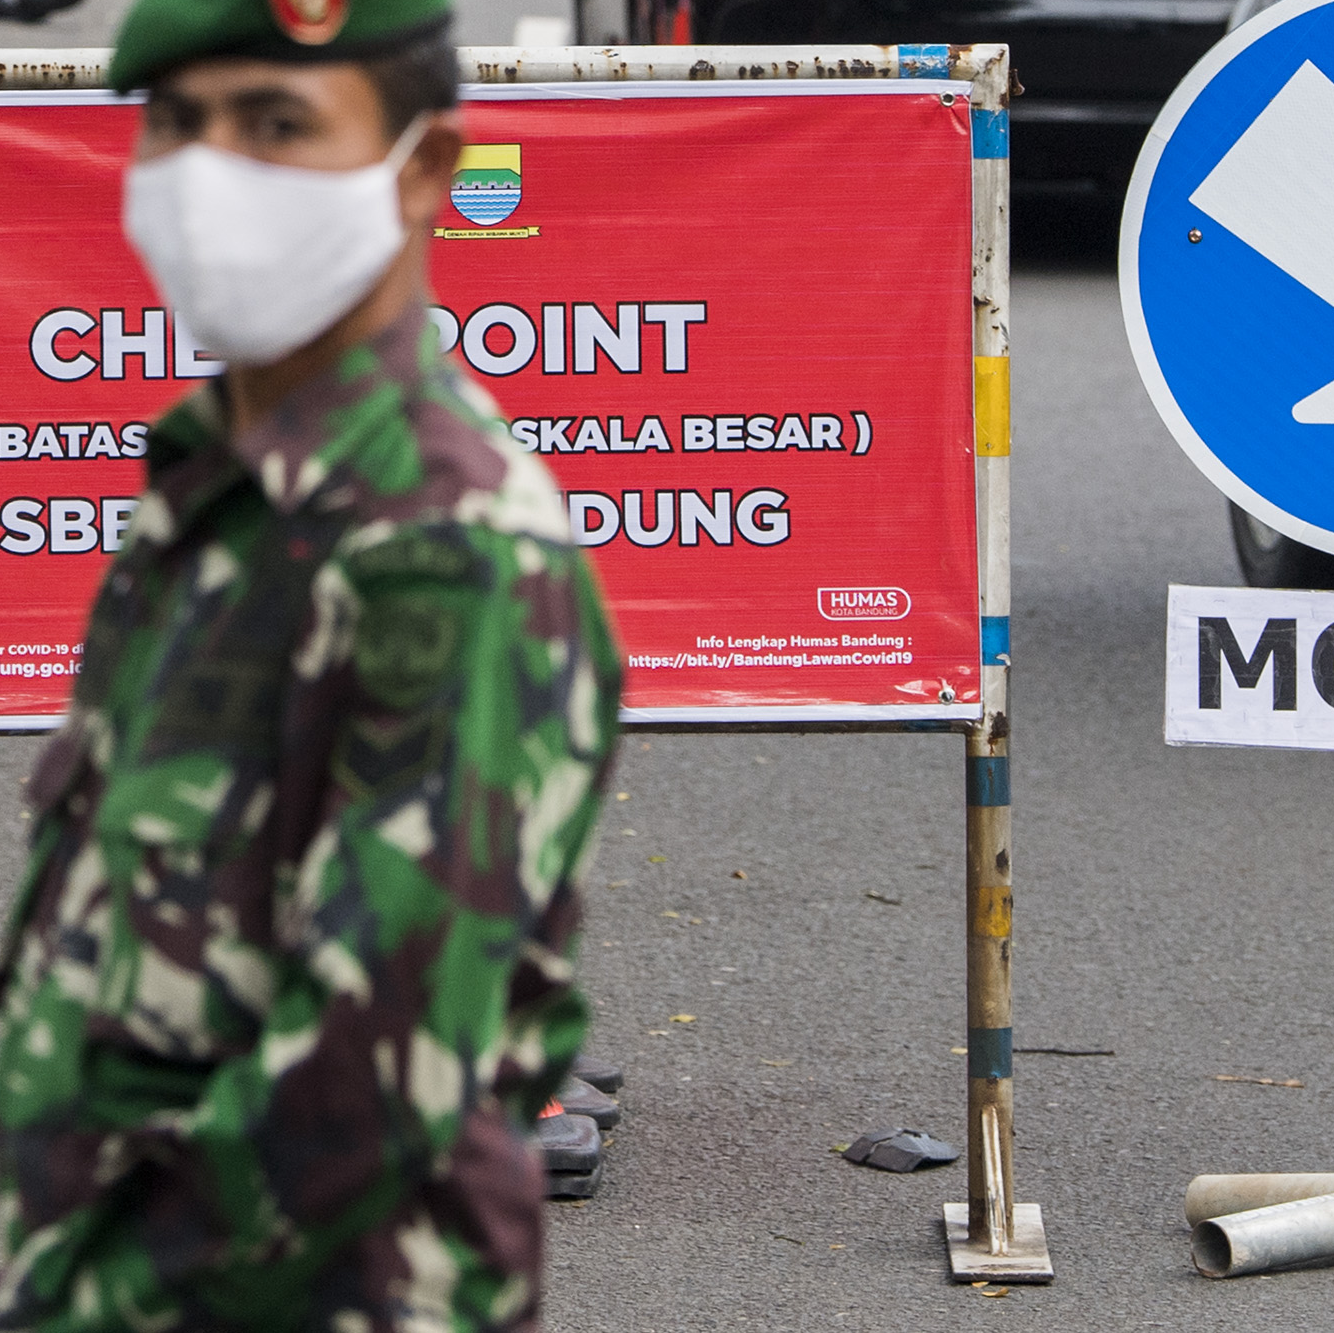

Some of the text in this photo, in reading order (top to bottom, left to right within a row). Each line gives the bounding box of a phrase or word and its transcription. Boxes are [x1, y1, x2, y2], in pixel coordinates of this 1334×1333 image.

[681, 413, 847, 453] BESAR
[557, 488, 791, 547] DUNG
[831, 592, 898, 607] HUMAS
[831, 607, 898, 616] KOTA BANDUNG
[8, 643, 68, 655] COVID-19
[697, 635, 725, 648] Info
[728, 635, 787, 650] Lengkap
[790, 635, 838, 647] Humas
[842, 634, 905, 648] Bandung
[629, 651, 913, 668] https://bit.ly/BandungLawanCovid19
